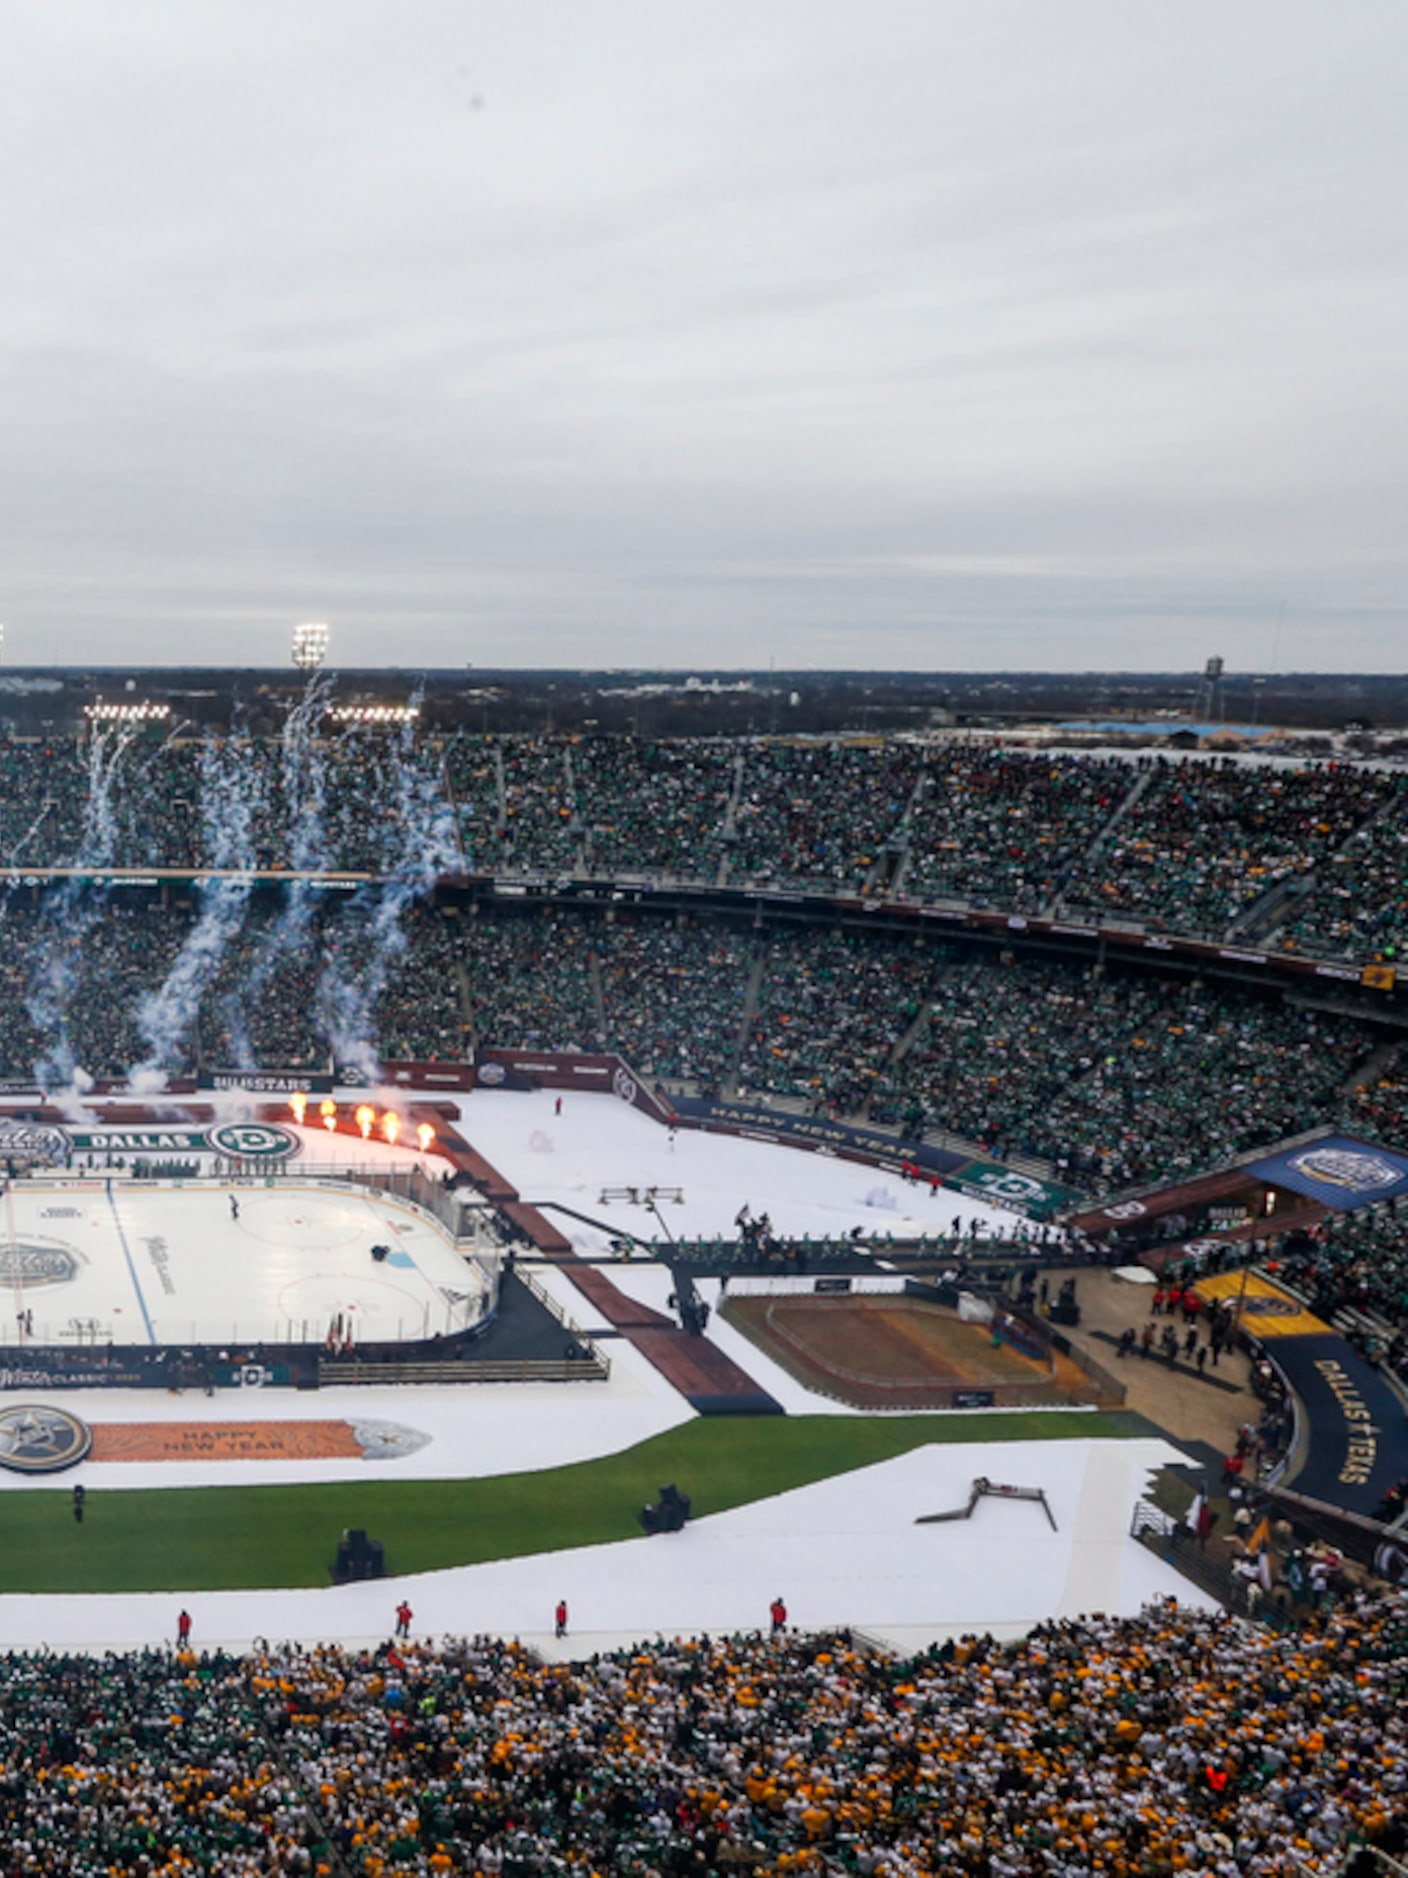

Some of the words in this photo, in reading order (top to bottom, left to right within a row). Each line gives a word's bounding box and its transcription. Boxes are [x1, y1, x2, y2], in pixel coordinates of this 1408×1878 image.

[711, 1107, 786, 1127] HAPPY
[793, 1123, 846, 1140] NEW
[853, 1136, 917, 1158] YEAR
[91, 1134, 193, 1149] DALLAS
[51, 1373, 110, 1384] CLASSIC
[1314, 1360, 1372, 1421] DALLAS
[182, 1430, 258, 1441] HAPPY
[163, 1442, 216, 1452] NEW
[227, 1441, 284, 1452] YEAR
[1338, 1437, 1377, 1485] TEXAS
